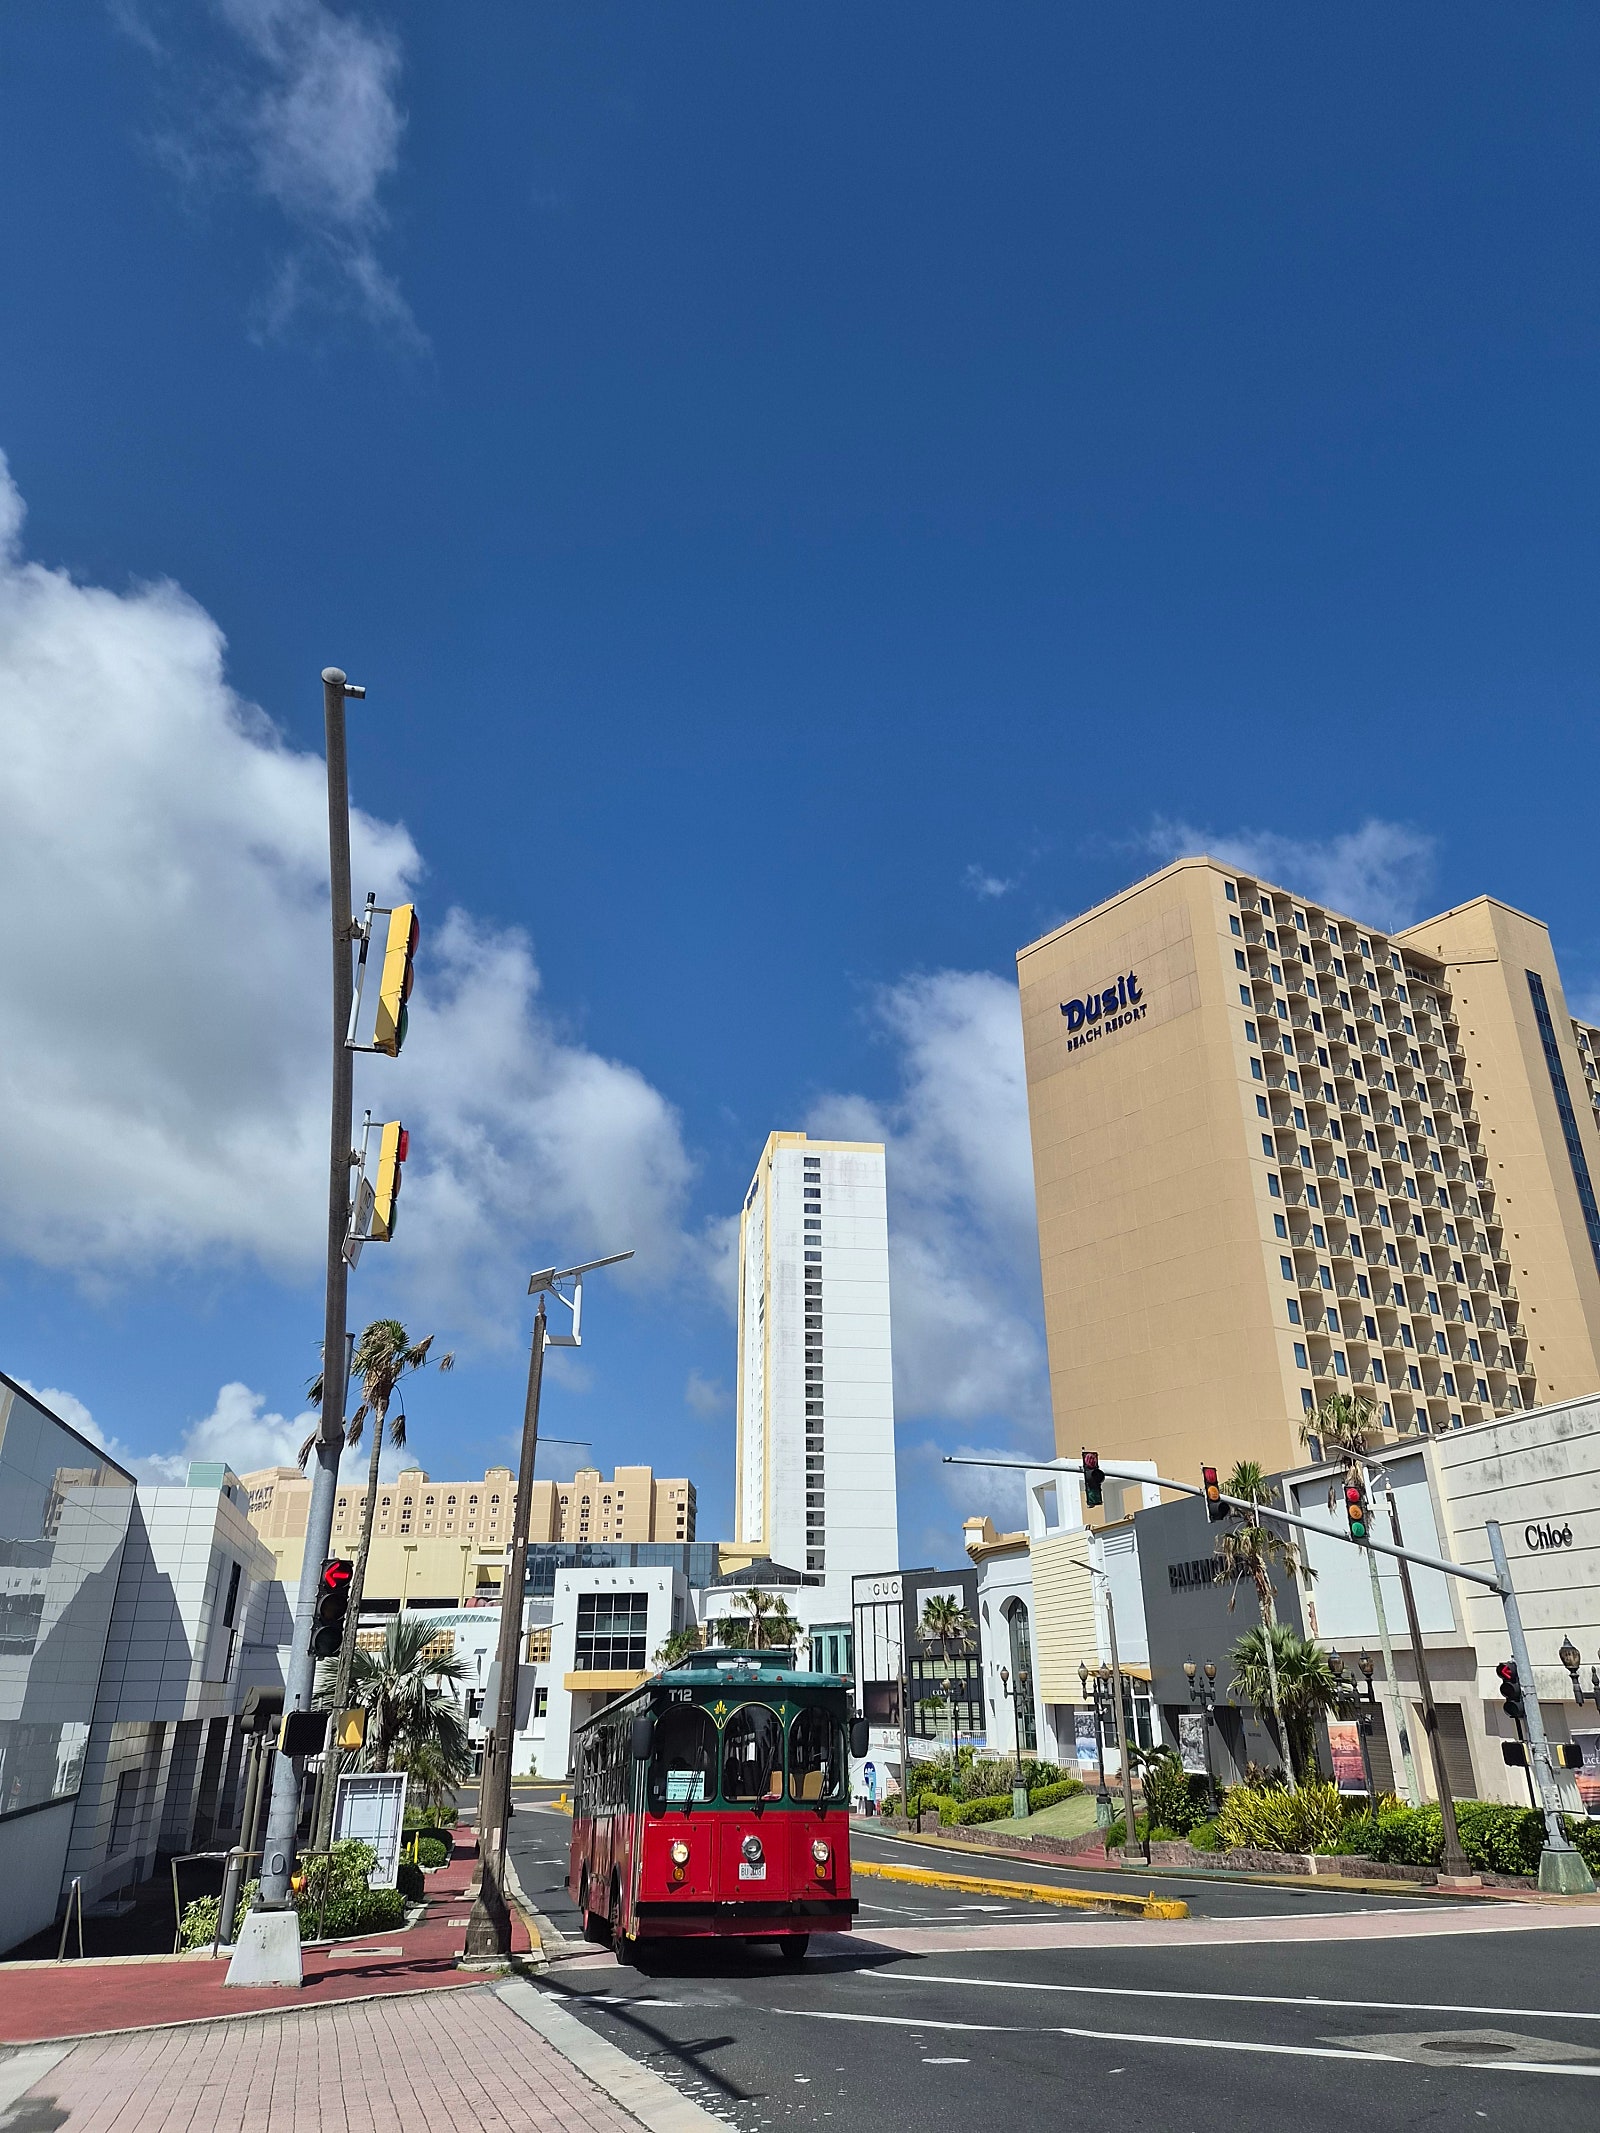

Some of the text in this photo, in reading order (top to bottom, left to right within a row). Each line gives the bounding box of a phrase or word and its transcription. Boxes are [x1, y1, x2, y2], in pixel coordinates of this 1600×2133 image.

[1060, 970, 1143, 1034] Dusit
[1067, 1003, 1148, 1052] BEACH RESORT
[249, 1486, 274, 1502] HYATT
[249, 1500, 272, 1513] EGENCY
[1525, 1522, 1573, 1551] Chloé
[1167, 1554, 1256, 1589] BALENCIG
[668, 1688, 693, 1702] T12
[932, 1688, 955, 1696] COA
[1582, 1756, 1600, 1765] LACE
